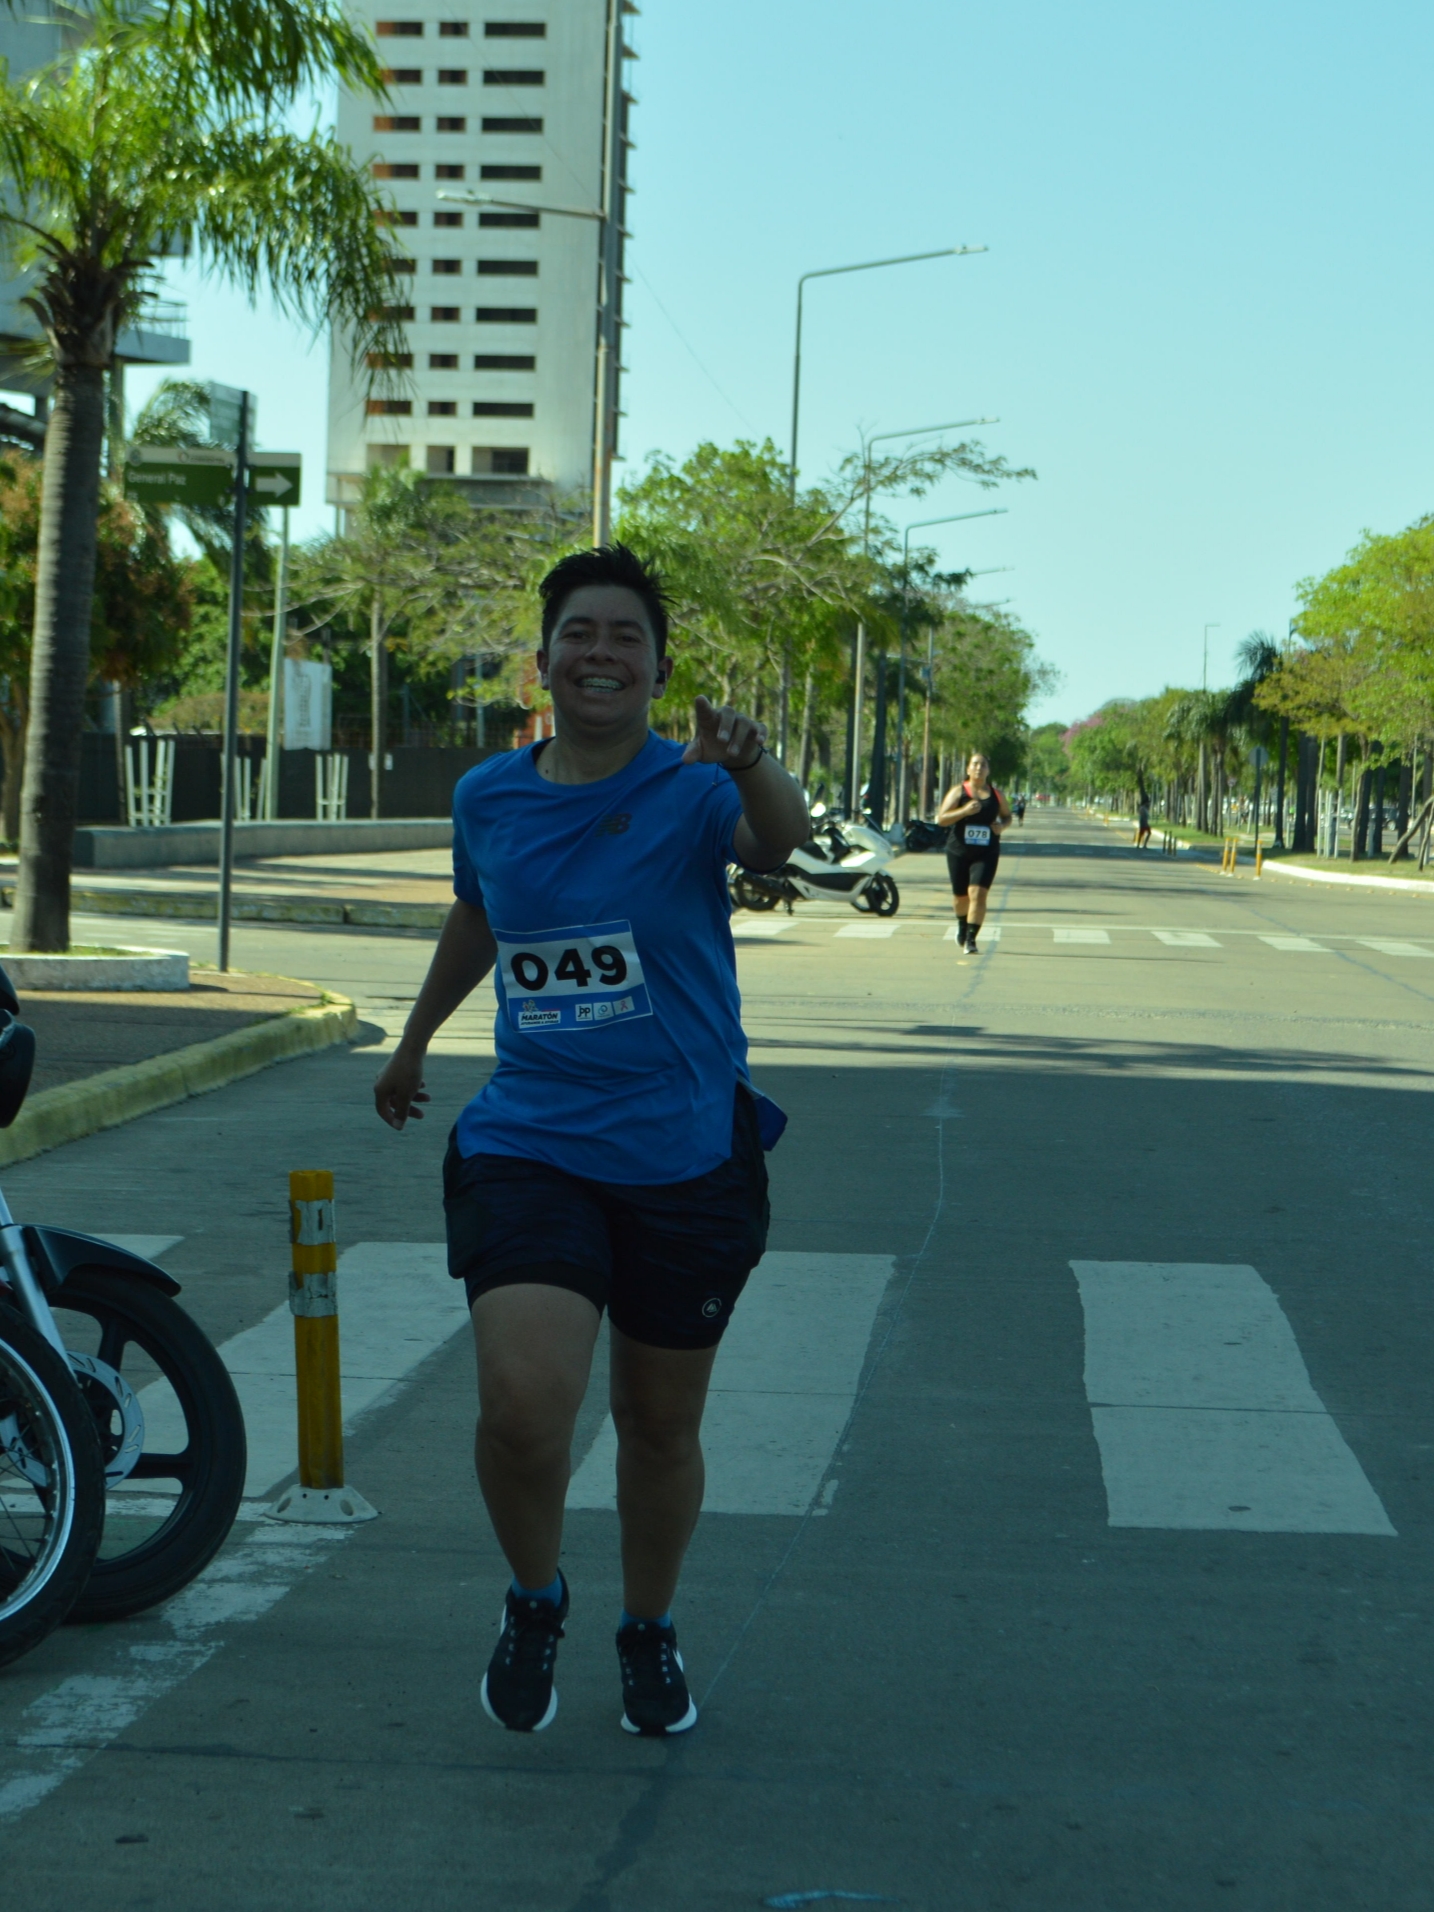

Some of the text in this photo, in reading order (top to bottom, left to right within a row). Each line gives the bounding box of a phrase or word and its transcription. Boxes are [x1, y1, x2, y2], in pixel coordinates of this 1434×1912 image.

[127, 471, 186, 486] General Paz
[968, 830, 987, 838] 078
[510, 945, 627, 991] 049
[521, 1012, 558, 1021] MARATÓN
